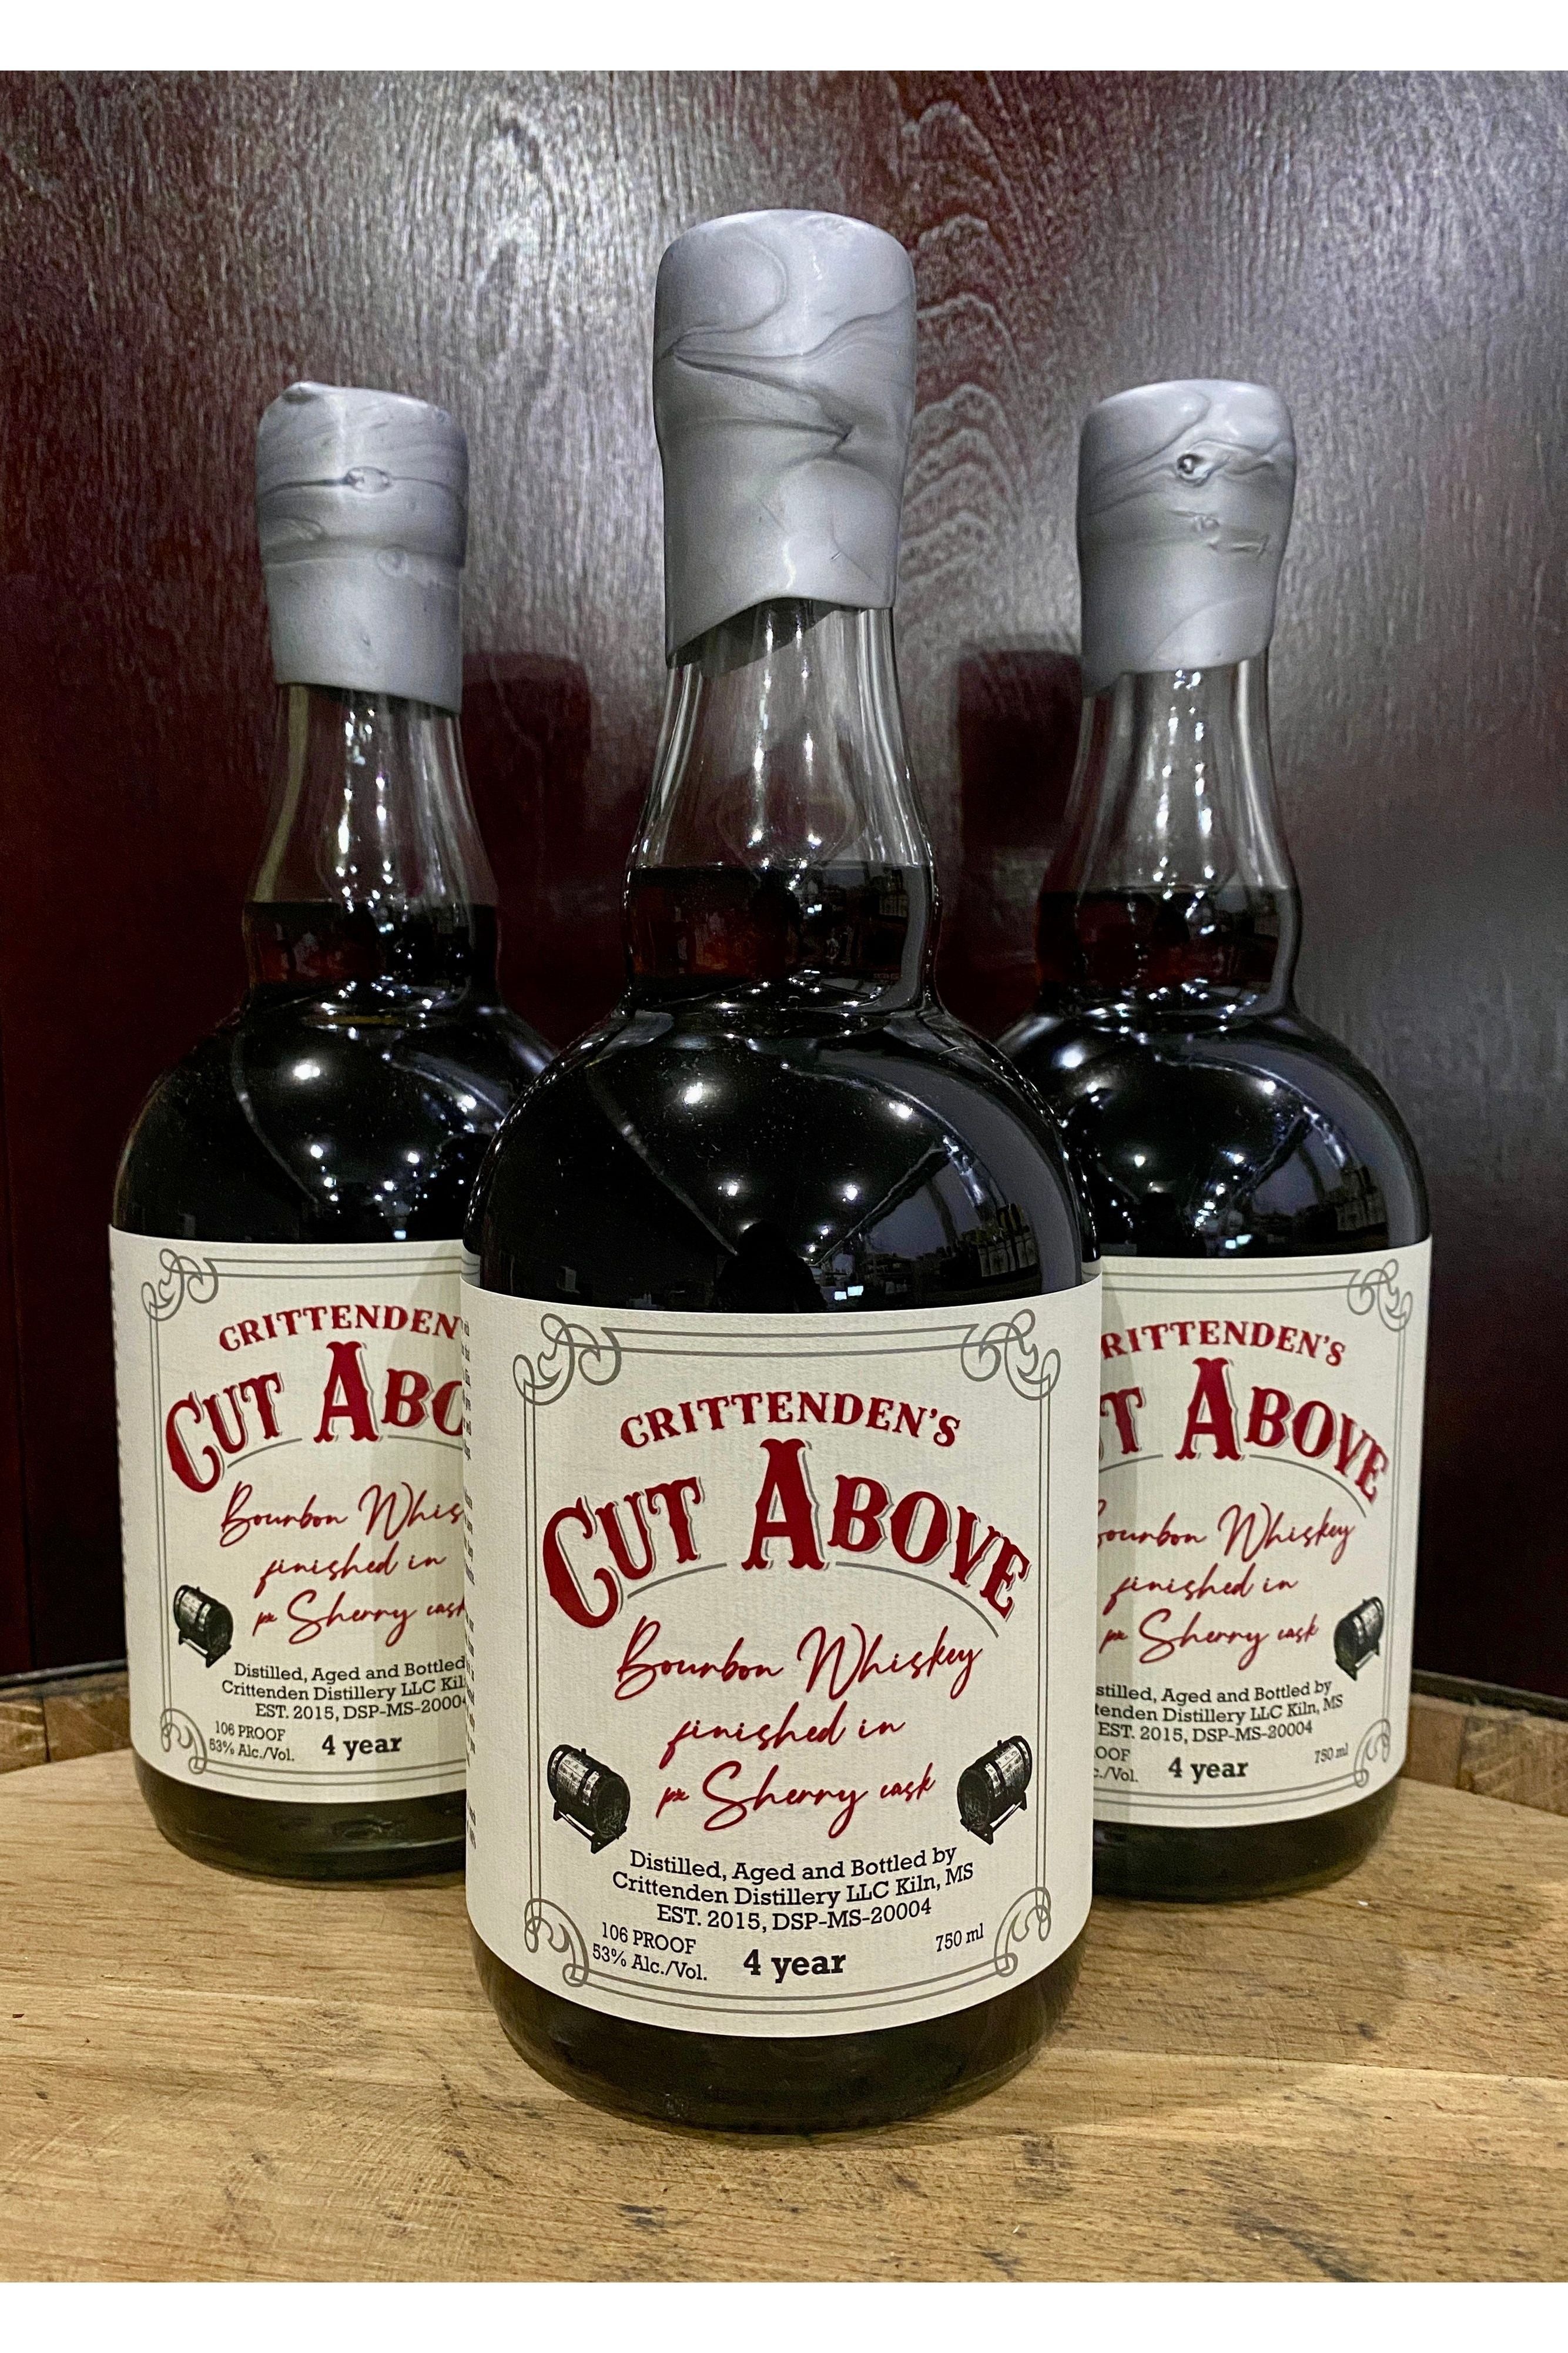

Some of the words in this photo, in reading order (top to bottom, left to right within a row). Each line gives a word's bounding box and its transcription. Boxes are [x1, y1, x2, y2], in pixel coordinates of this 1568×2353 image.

[165, 1372, 282, 1494] CUT
[620, 1391, 961, 1448] CRITTENDEN'S
[1175, 1357, 1388, 1503] ABOVE
[219, 1481, 348, 1548] Bourbon
[542, 1476, 705, 1629] CUT
[741, 1438, 1030, 1622] ABOVE
[1217, 1502, 1355, 1565] Whiskey
[253, 1541, 400, 1599] finished
[408, 1555, 447, 1570] in
[1102, 1562, 1256, 1616] finished
[1262, 1578, 1298, 1593] in
[287, 1589, 417, 1648] Sherry
[614, 1615, 784, 1701] Bourbon
[797, 1623, 983, 1700] Whiskey
[1138, 1608, 1269, 1671] Sherry
[1277, 1614, 1318, 1644] cask
[222, 1679, 310, 1701] Crittenden
[313, 1686, 397, 1702] Distillery
[401, 1679, 435, 1697] LLC
[441, 1675, 466, 1692] Kil
[234, 1662, 307, 1683] Distilled,
[311, 1666, 361, 1685] Aged
[366, 1663, 400, 1680] and
[404, 1655, 465, 1676] Bottled
[255, 1703, 289, 1719] EST.
[293, 1705, 339, 1722] 2015,
[343, 1694, 467, 1719] DSP-MS-2000
[1161, 1688, 1212, 1706] Aged
[1217, 1688, 1250, 1703] and
[1254, 1681, 1311, 1701] Bottled
[1314, 1680, 1332, 1698] by
[1162, 1708, 1246, 1726] Distillery
[1250, 1705, 1282, 1721] LLC
[1286, 1701, 1319, 1718] Kiln,
[1323, 1694, 1343, 1711] MS
[216, 1720, 235, 1736] 106
[238, 1725, 286, 1742] PROOF
[321, 1734, 336, 1756] 4
[343, 1737, 403, 1761] year
[658, 1701, 846, 1770] finished
[858, 1719, 906, 1739] in
[1098, 1723, 1135, 1739] EST.
[1140, 1726, 1188, 1745] 2015,
[1192, 1720, 1312, 1743] DSP-MS-20004
[237, 1743, 294, 1762] Alc./Vol.
[1094, 1746, 1130, 1762] OOF
[1168, 1756, 1182, 1778] 4
[1190, 1762, 1249, 1785] year
[1315, 1747, 1334, 1764] 750
[702, 1760, 869, 1839] Sherry
[880, 1762, 936, 1802] cask
[630, 1849, 726, 1882] Distilled,
[731, 1862, 796, 1886] Aged
[802, 1860, 846, 1880] and
[850, 1849, 927, 1877] Bottled
[932, 1846, 957, 1870] by
[612, 1871, 729, 1904] Crittenden
[734, 1887, 841, 1909] Distillery
[846, 1880, 889, 1903] LLC
[895, 1875, 940, 1896] Kiln,
[945, 1862, 973, 1886] MS
[656, 1903, 702, 1926] EST.
[707, 1910, 767, 1933] 2015,
[772, 1897, 932, 1930] DSP-MS-20004
[602, 1922, 628, 1943] 106
[632, 1929, 696, 1954] PROOF
[936, 1930, 962, 1953] 750
[966, 1923, 984, 1944] ml
[592, 1943, 626, 1967] 53%
[631, 1953, 707, 1981] Alc./Vol.
[743, 1949, 761, 1976] 4
[770, 1954, 846, 1984] year
